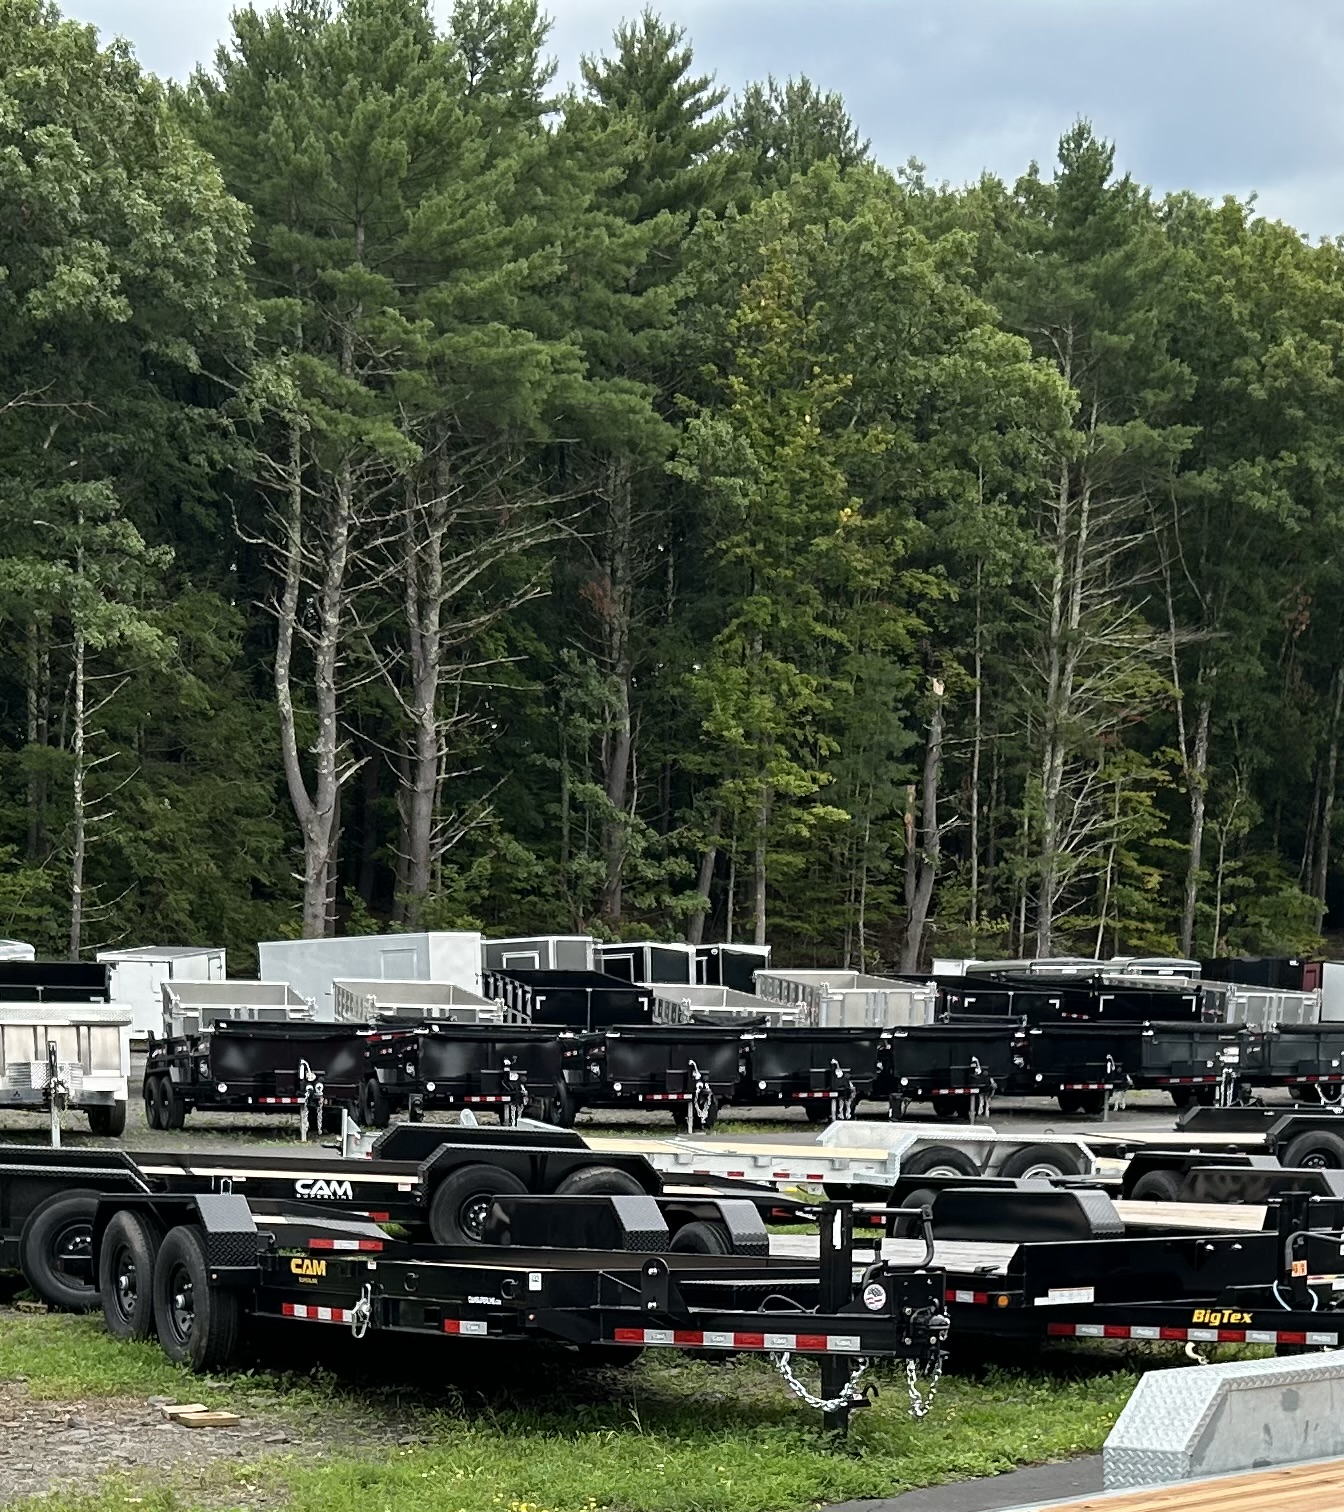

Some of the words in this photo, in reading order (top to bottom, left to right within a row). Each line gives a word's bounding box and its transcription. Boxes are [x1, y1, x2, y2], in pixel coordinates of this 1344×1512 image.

[295, 1180, 353, 1197] CAM
[290, 1258, 327, 1277] CAM
[1191, 1309, 1253, 1326] BigTex
